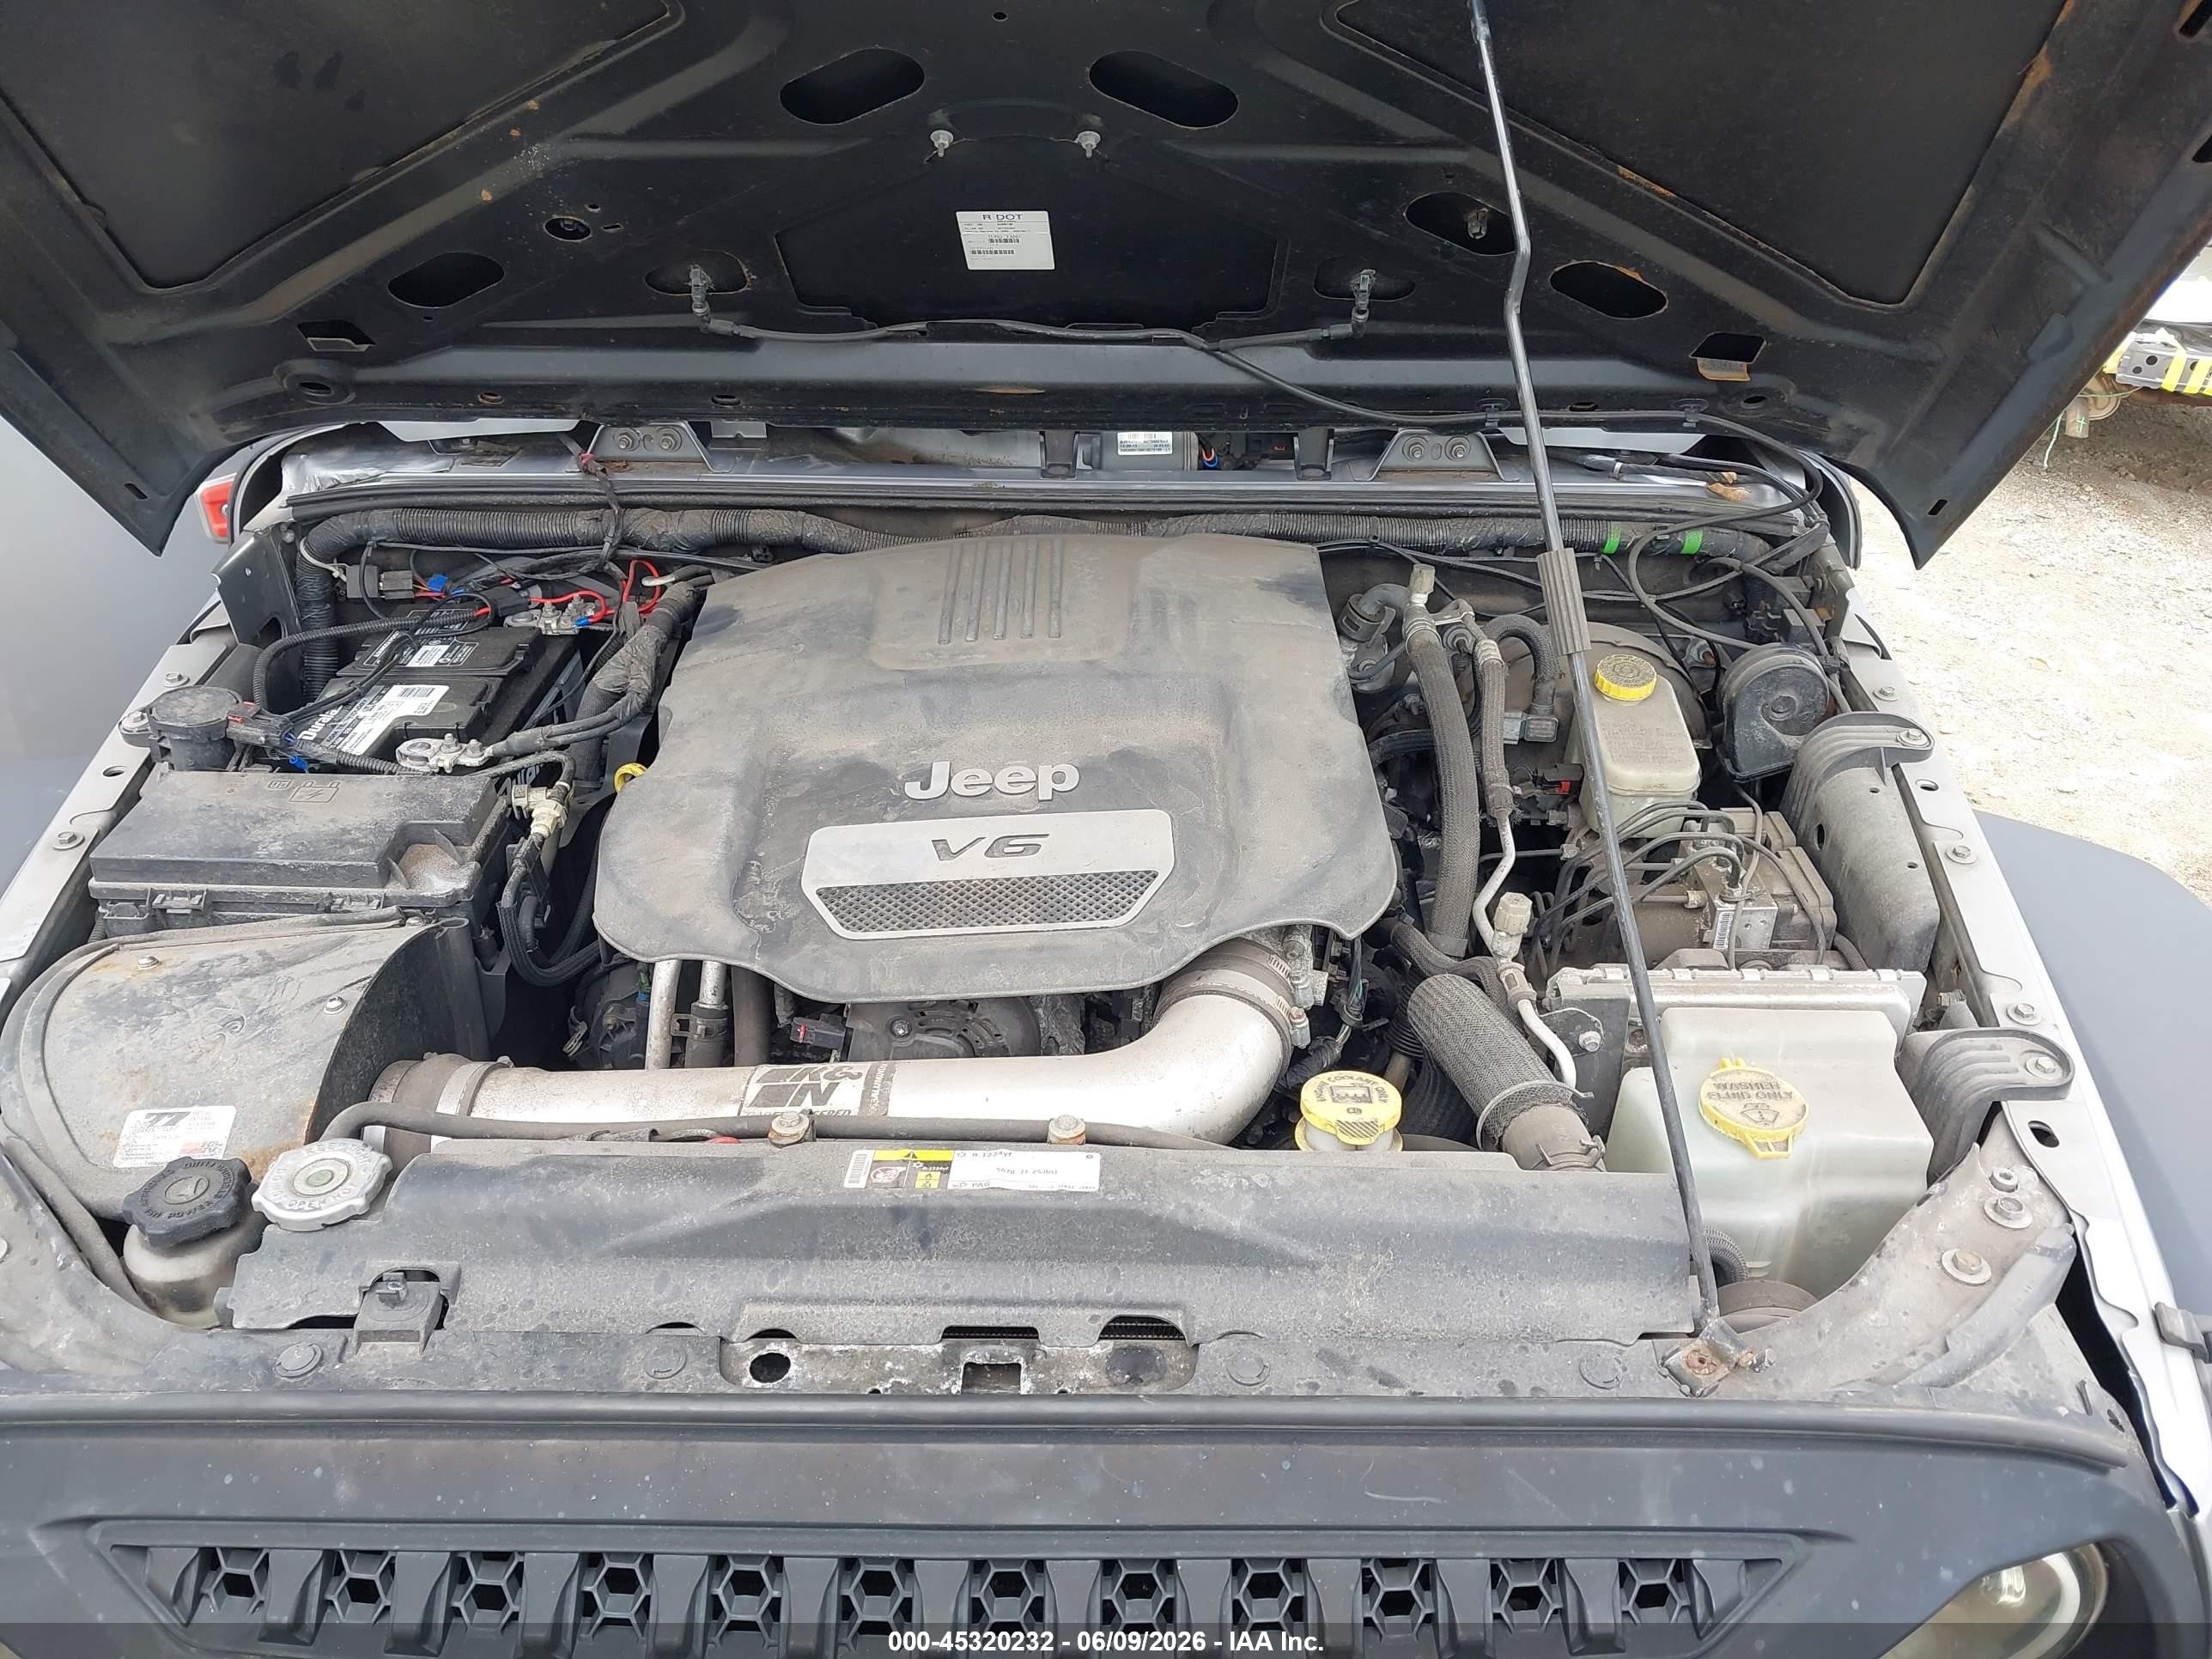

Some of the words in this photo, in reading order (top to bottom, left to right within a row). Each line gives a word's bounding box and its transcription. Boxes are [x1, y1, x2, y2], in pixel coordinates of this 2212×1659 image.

[296, 704, 343, 742] Durala
[904, 761, 1080, 801] Jeep
[931, 833, 1050, 861] V6
[1375, 1086, 1389, 1103] ONLY
[1706, 1091, 1752, 1101] FLUID
[1755, 1091, 1794, 1100] ONLY
[1713, 1081, 1782, 1091] WASHER
